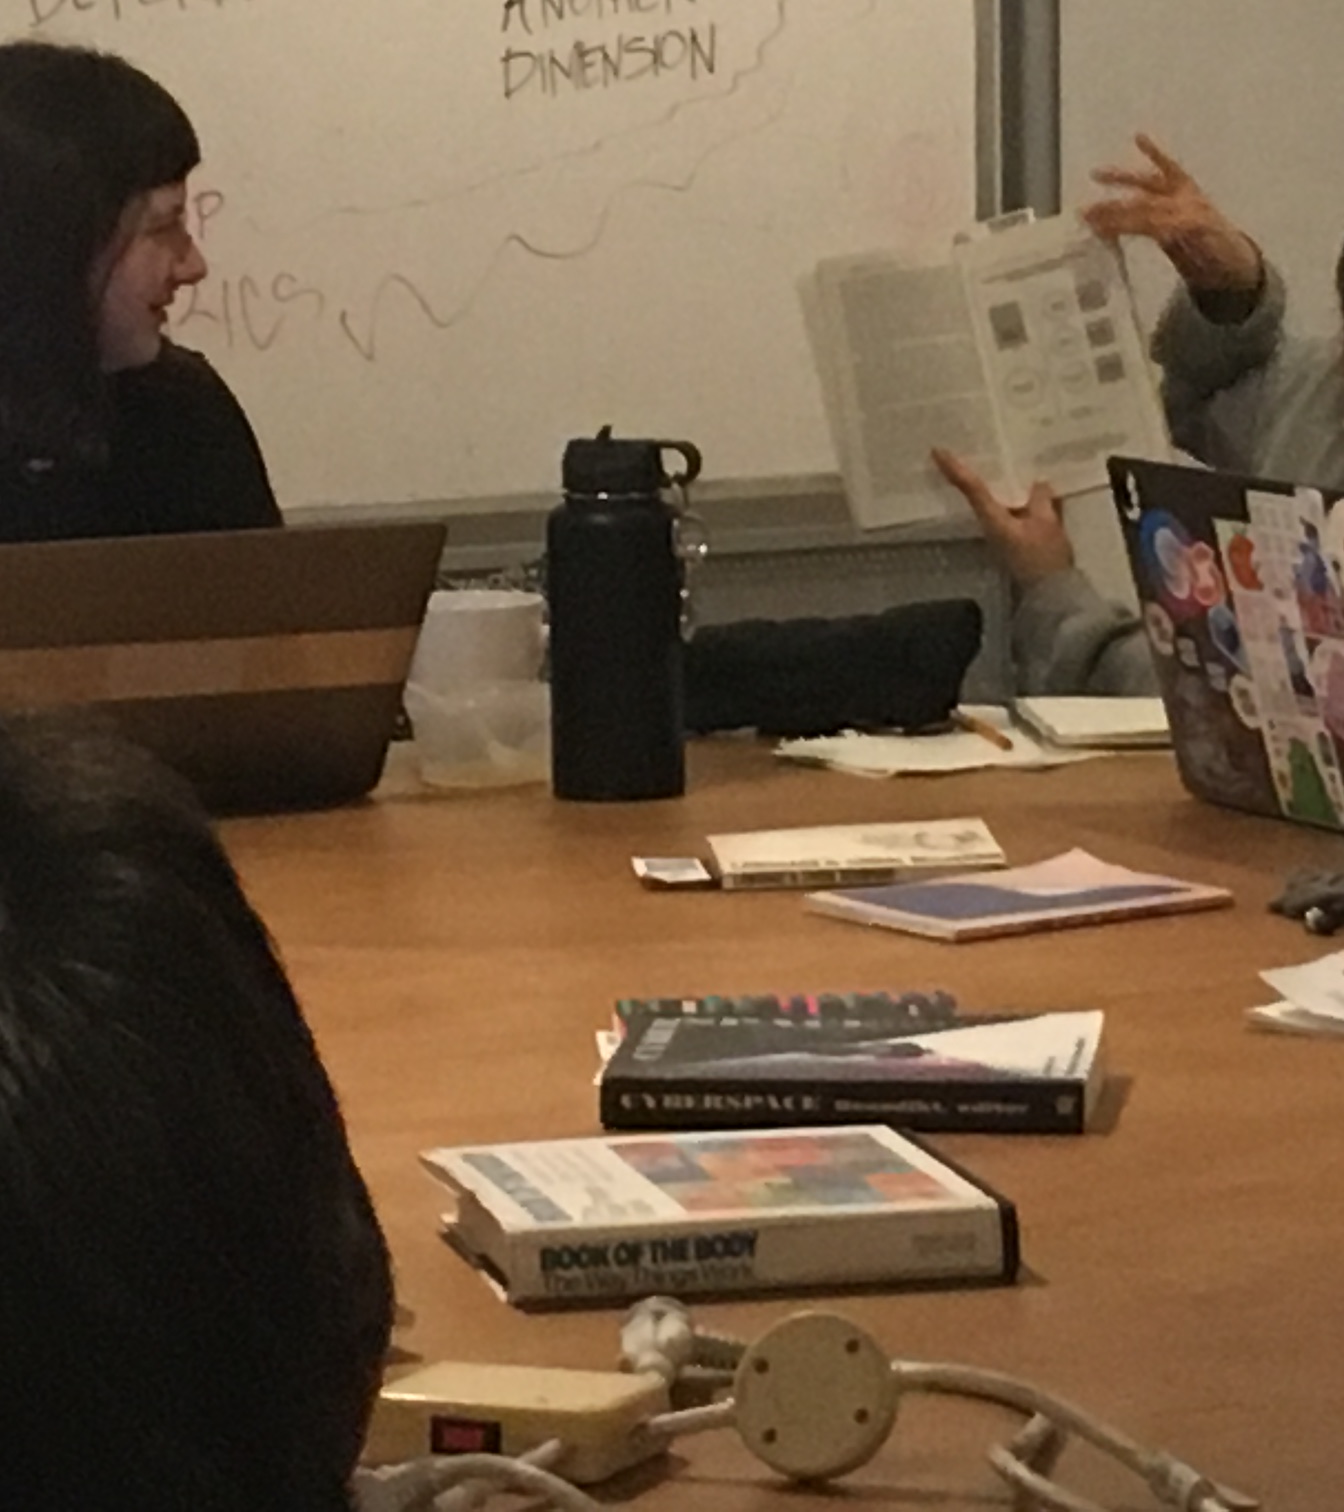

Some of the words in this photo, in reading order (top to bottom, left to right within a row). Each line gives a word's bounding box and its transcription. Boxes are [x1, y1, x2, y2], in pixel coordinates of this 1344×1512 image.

[500, 21, 716, 100] DIMENSION
[621, 1092, 820, 1112] CYBERSPACE
[540, 1244, 608, 1272] BOOK
[613, 1240, 641, 1267] OF
[648, 1235, 690, 1264] THE
[694, 1229, 757, 1261] BODY
